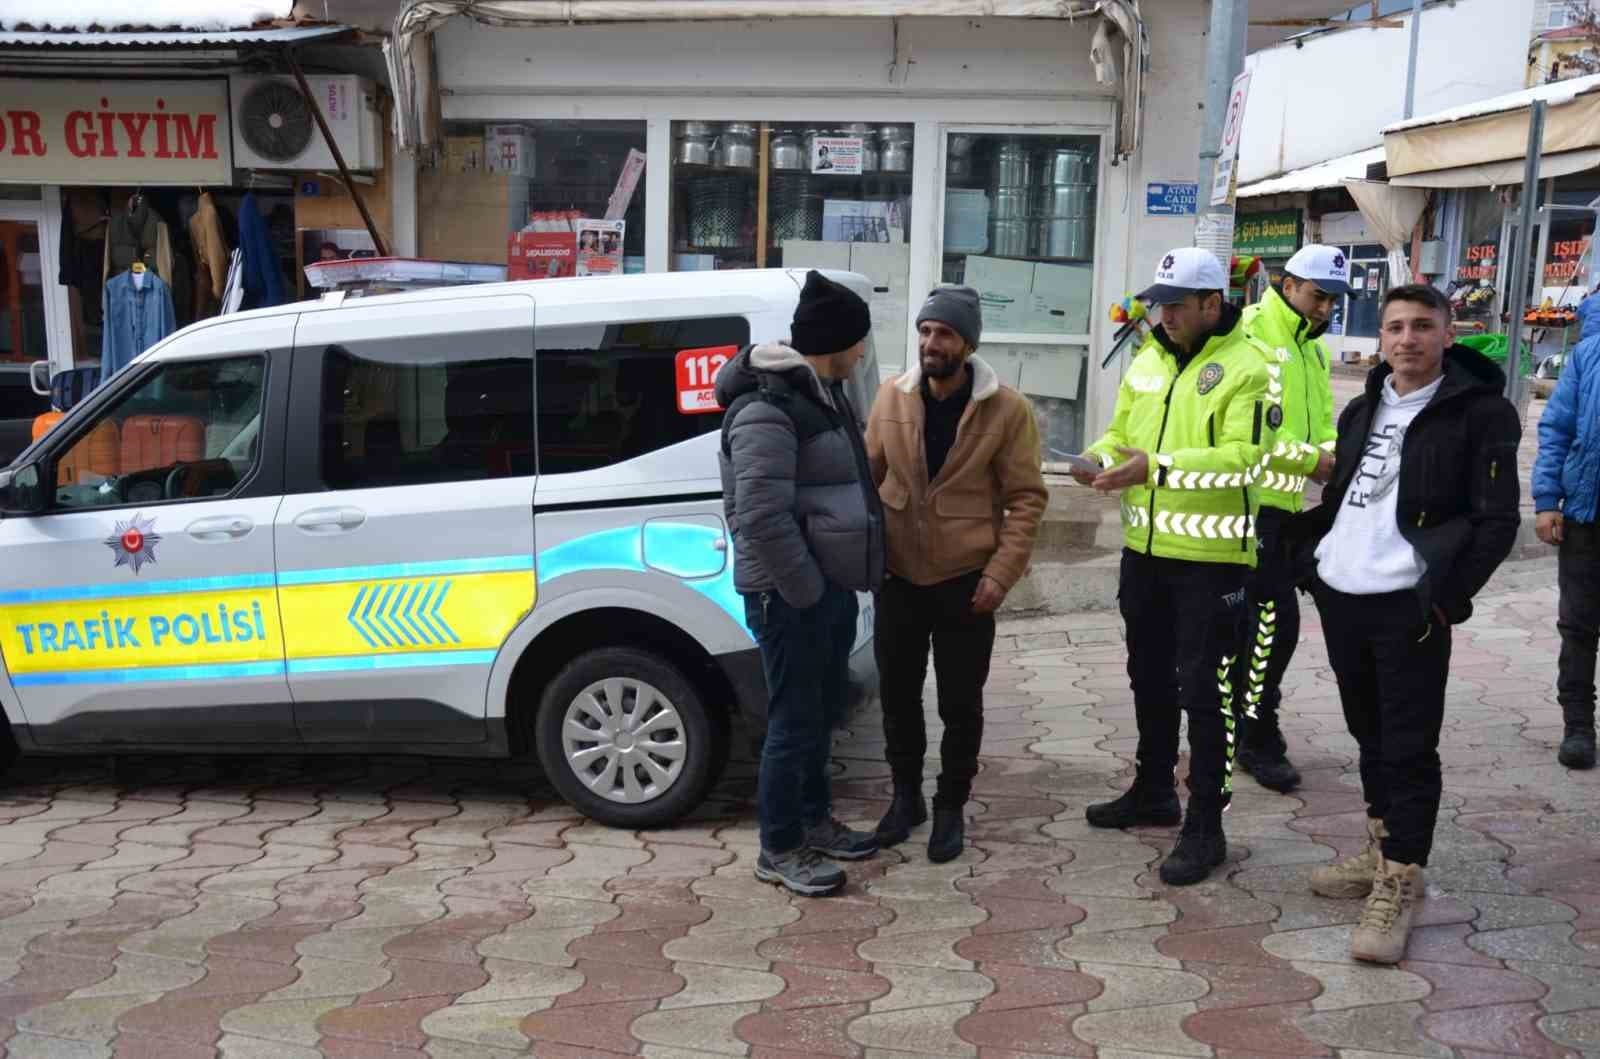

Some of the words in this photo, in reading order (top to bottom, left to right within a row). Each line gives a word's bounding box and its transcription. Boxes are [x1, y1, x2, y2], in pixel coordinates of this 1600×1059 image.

[64, 97, 219, 160] GİYİM
[684, 354, 728, 386] 112
[16, 609, 141, 655] TRAFİK
[150, 600, 266, 647] POLİSİ
